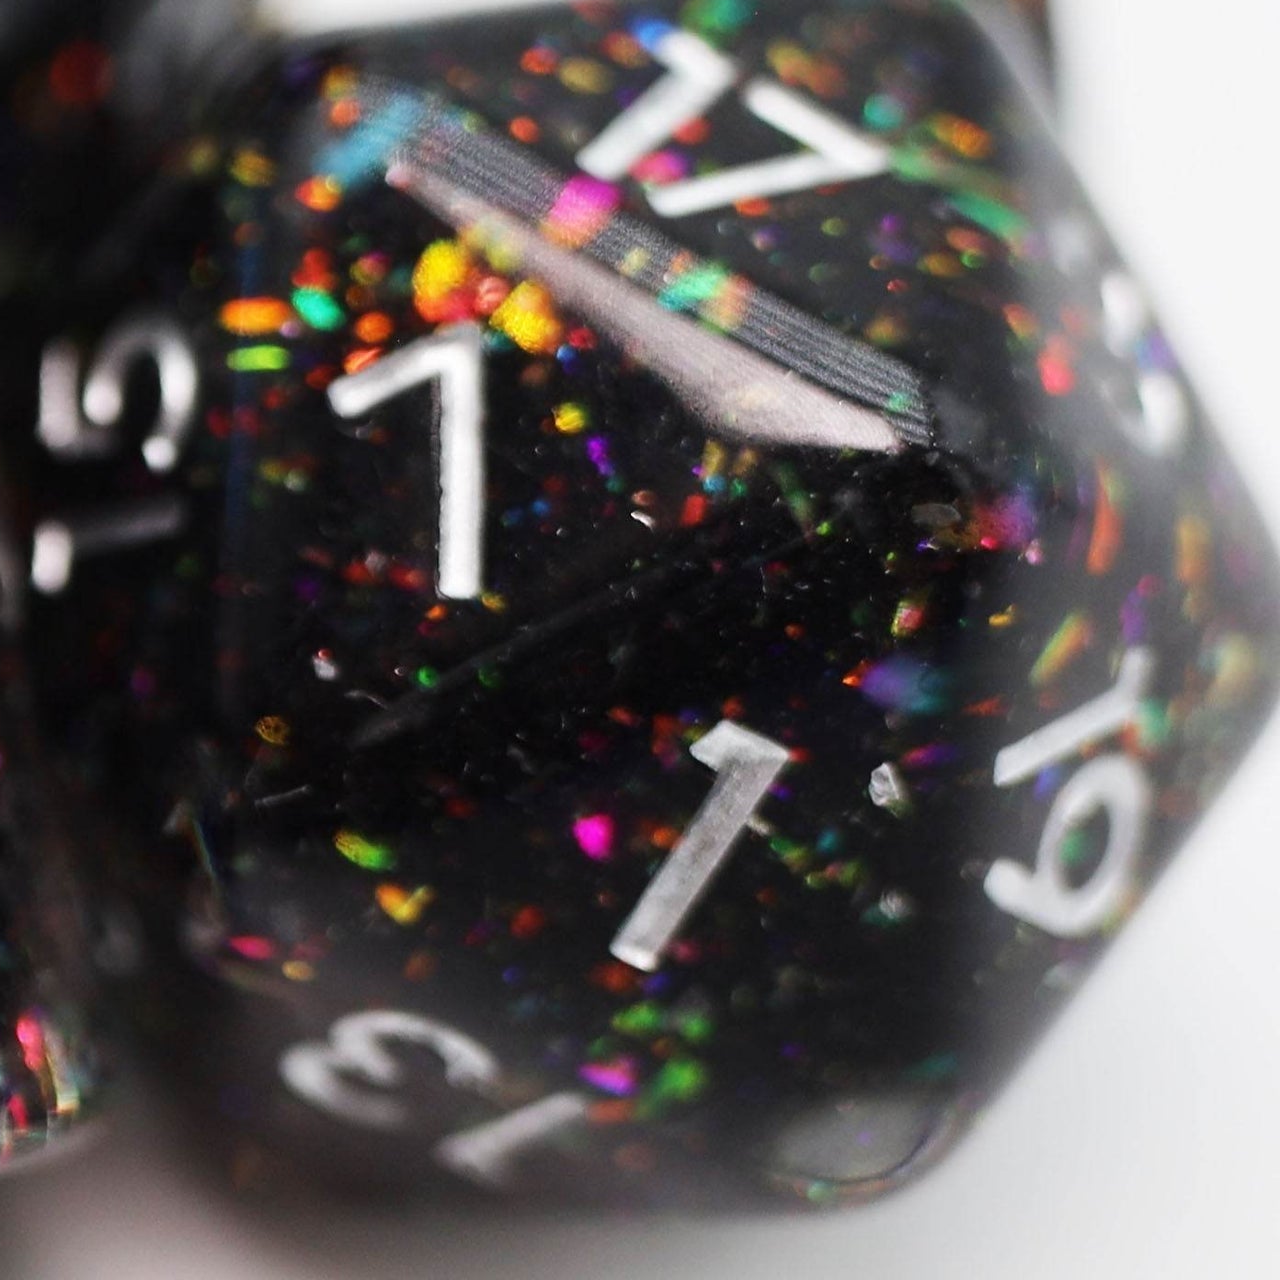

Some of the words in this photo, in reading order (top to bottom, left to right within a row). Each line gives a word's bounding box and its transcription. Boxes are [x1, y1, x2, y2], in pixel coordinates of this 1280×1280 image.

[577, 24, 889, 217] 17
[30, 300, 200, 595] 15
[611, 718, 789, 972] 1
